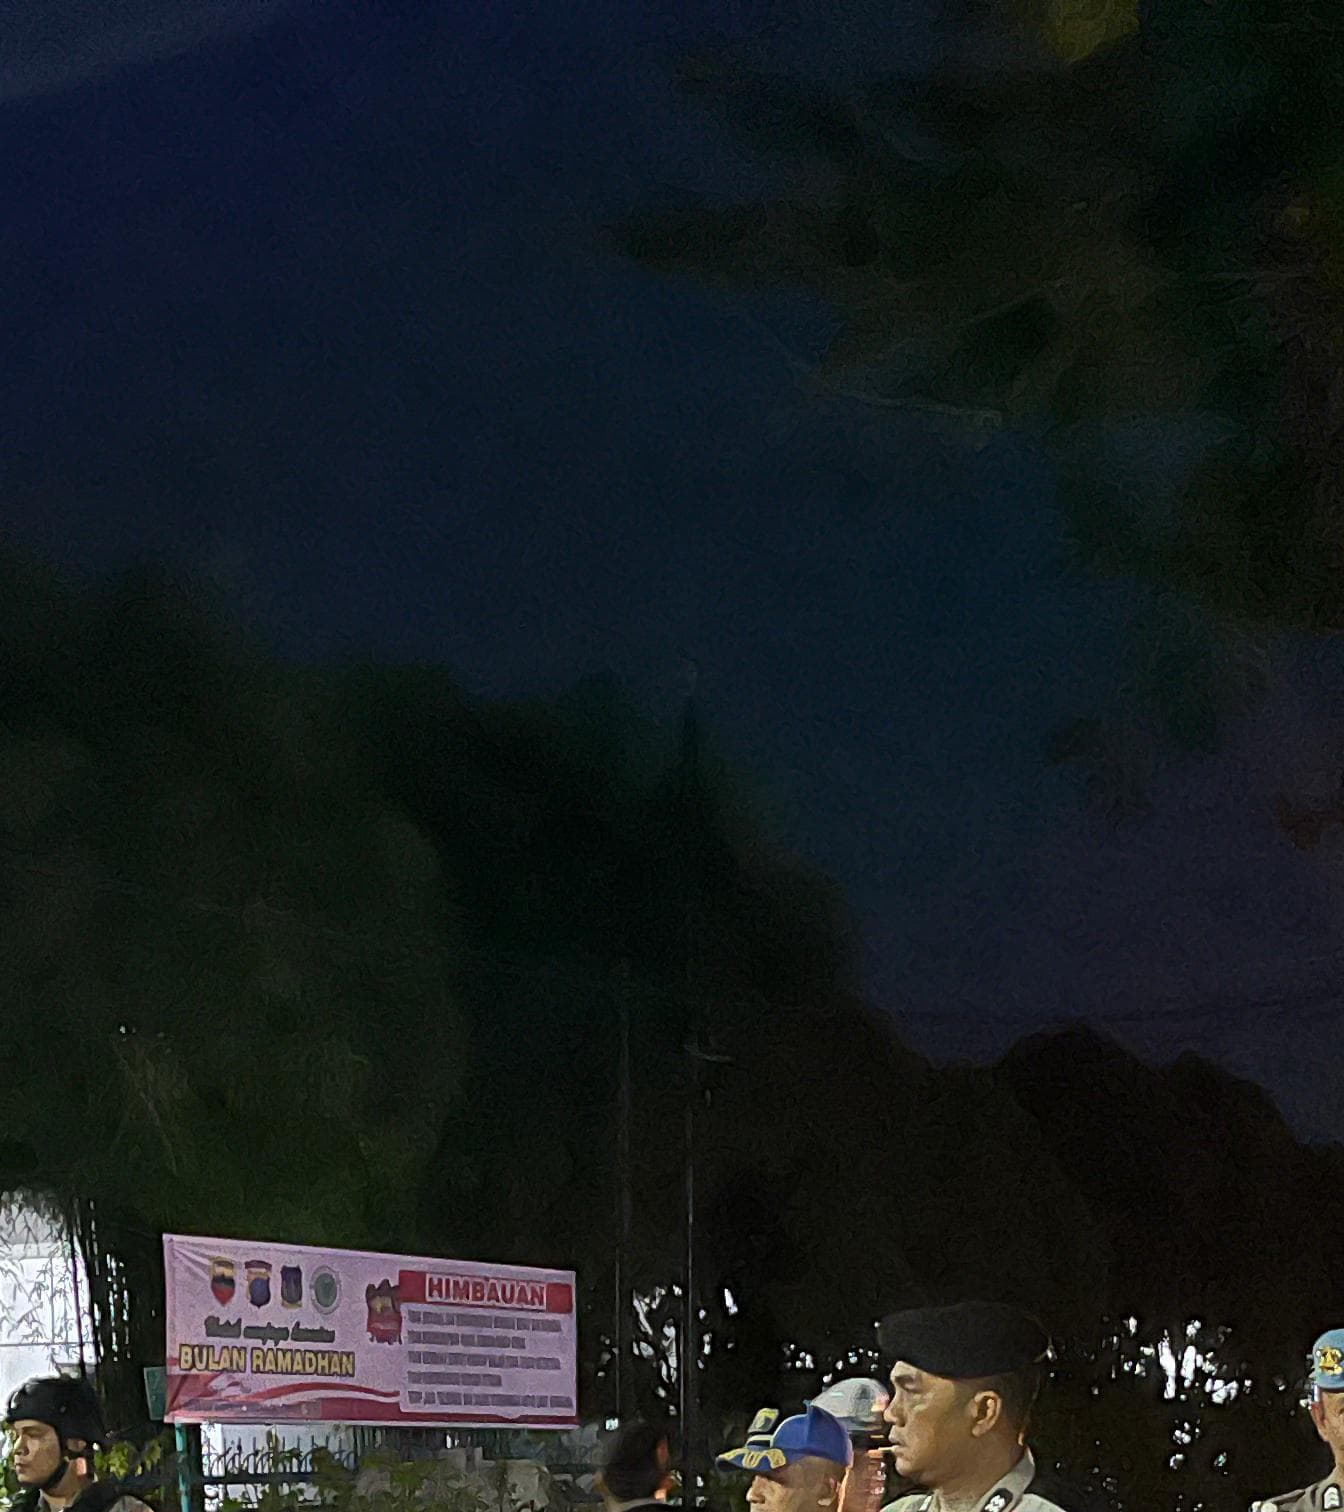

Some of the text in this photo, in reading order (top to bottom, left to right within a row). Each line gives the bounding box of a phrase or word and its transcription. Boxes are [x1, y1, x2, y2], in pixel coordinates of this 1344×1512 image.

[428, 1275, 545, 1307] HIMBAUAN
[179, 1343, 355, 1377] BULAN RAMADHAN
